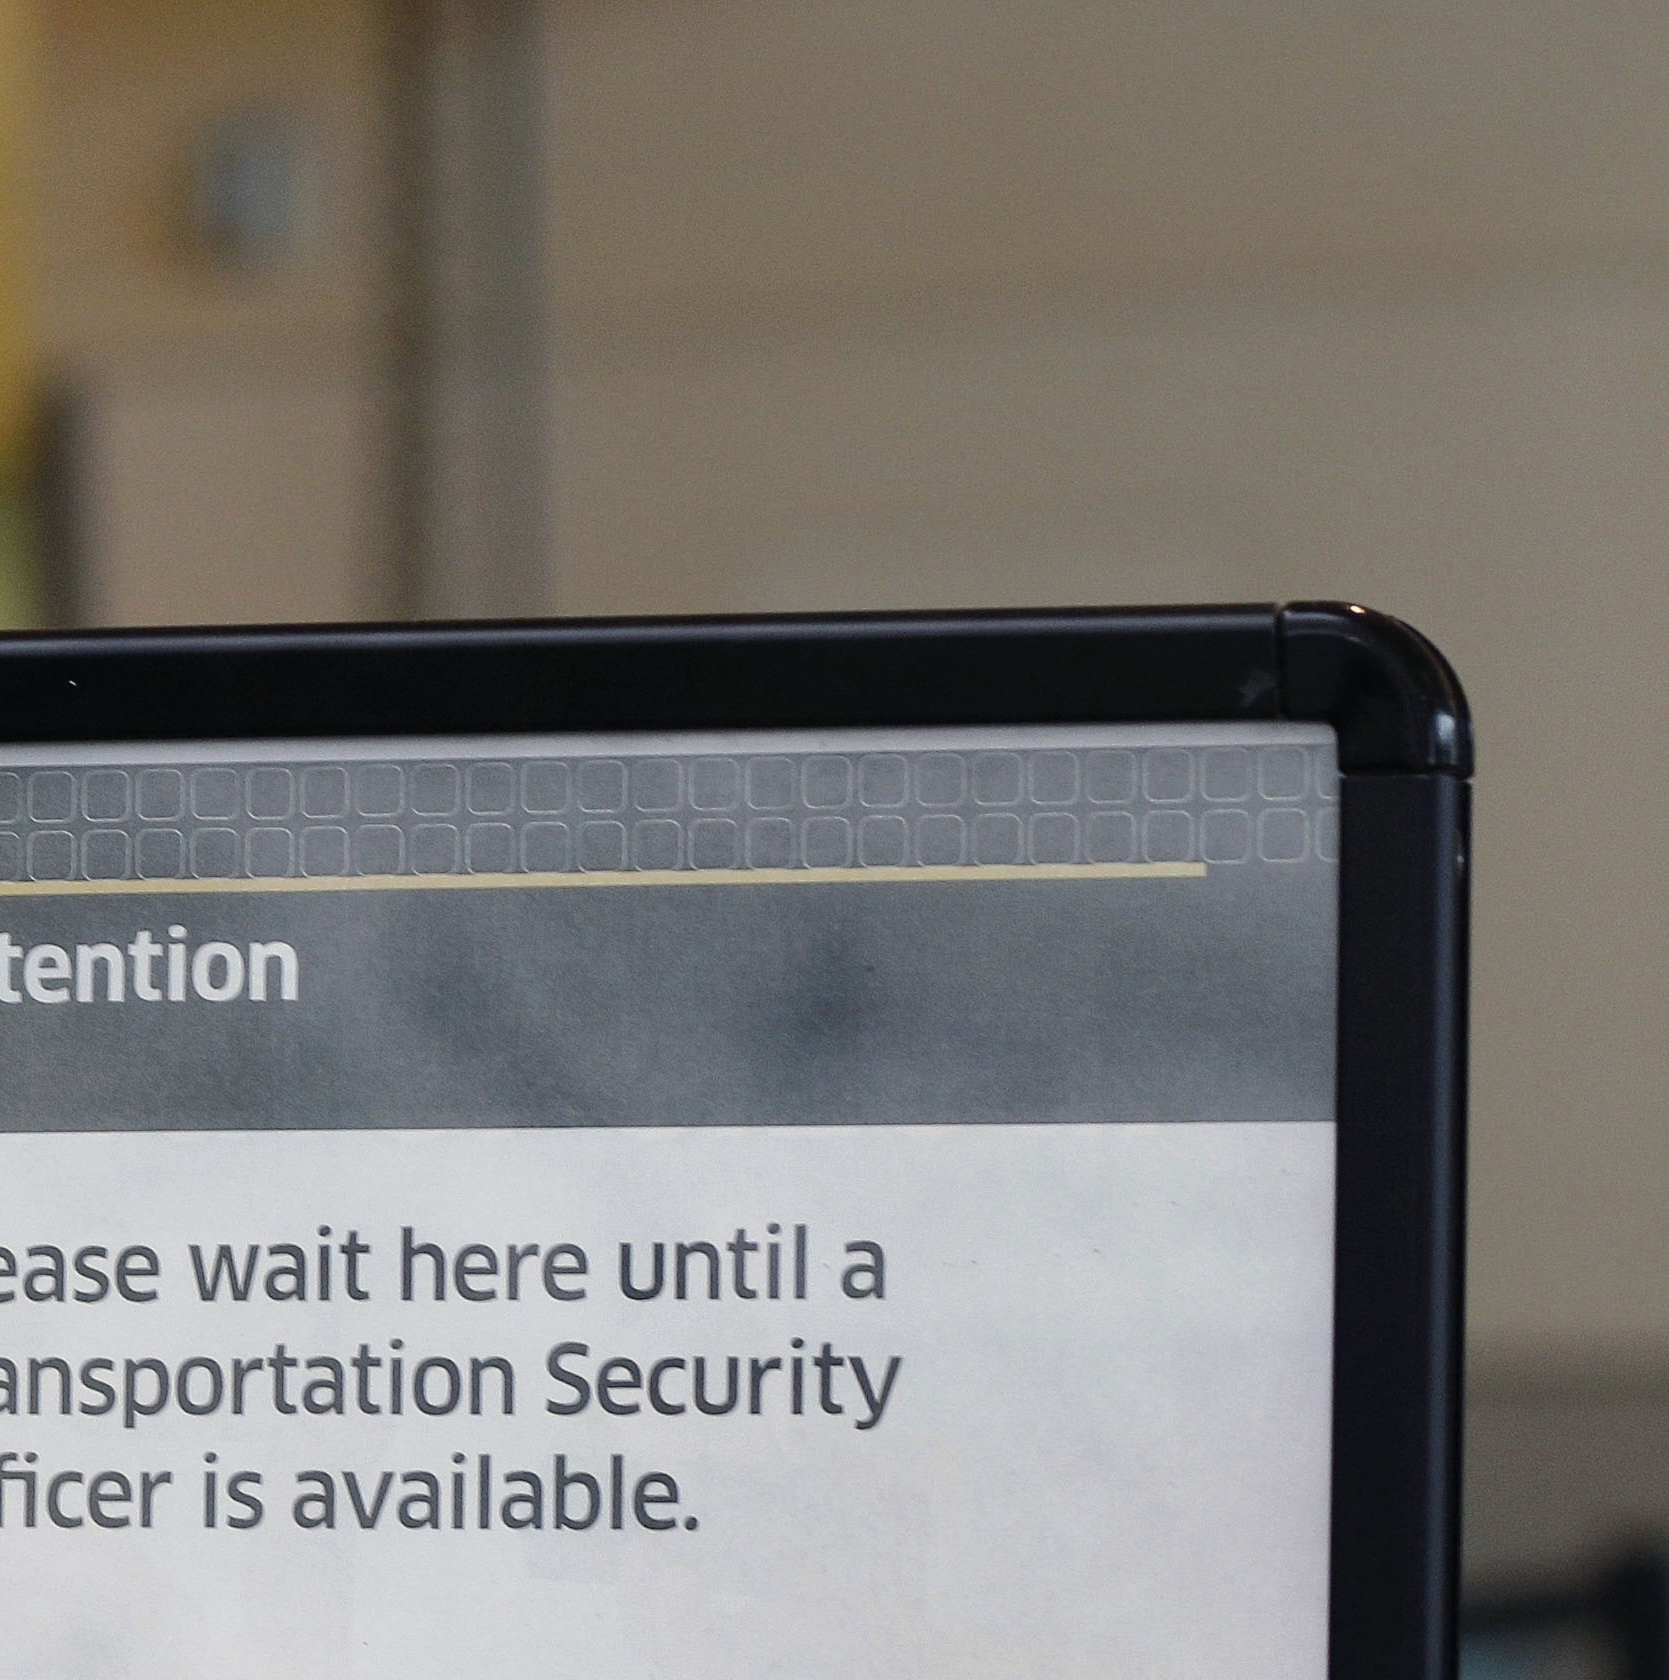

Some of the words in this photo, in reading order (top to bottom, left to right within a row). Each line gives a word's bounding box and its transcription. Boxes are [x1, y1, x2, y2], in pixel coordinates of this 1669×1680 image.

[188, 1225, 370, 1302] wait
[401, 1226, 588, 1302] here
[620, 1223, 807, 1301] until
[842, 1240, 885, 1299] a
[546, 1337, 902, 1431] Security
[204, 1452, 263, 1530] is
[293, 1452, 698, 1531] available.
